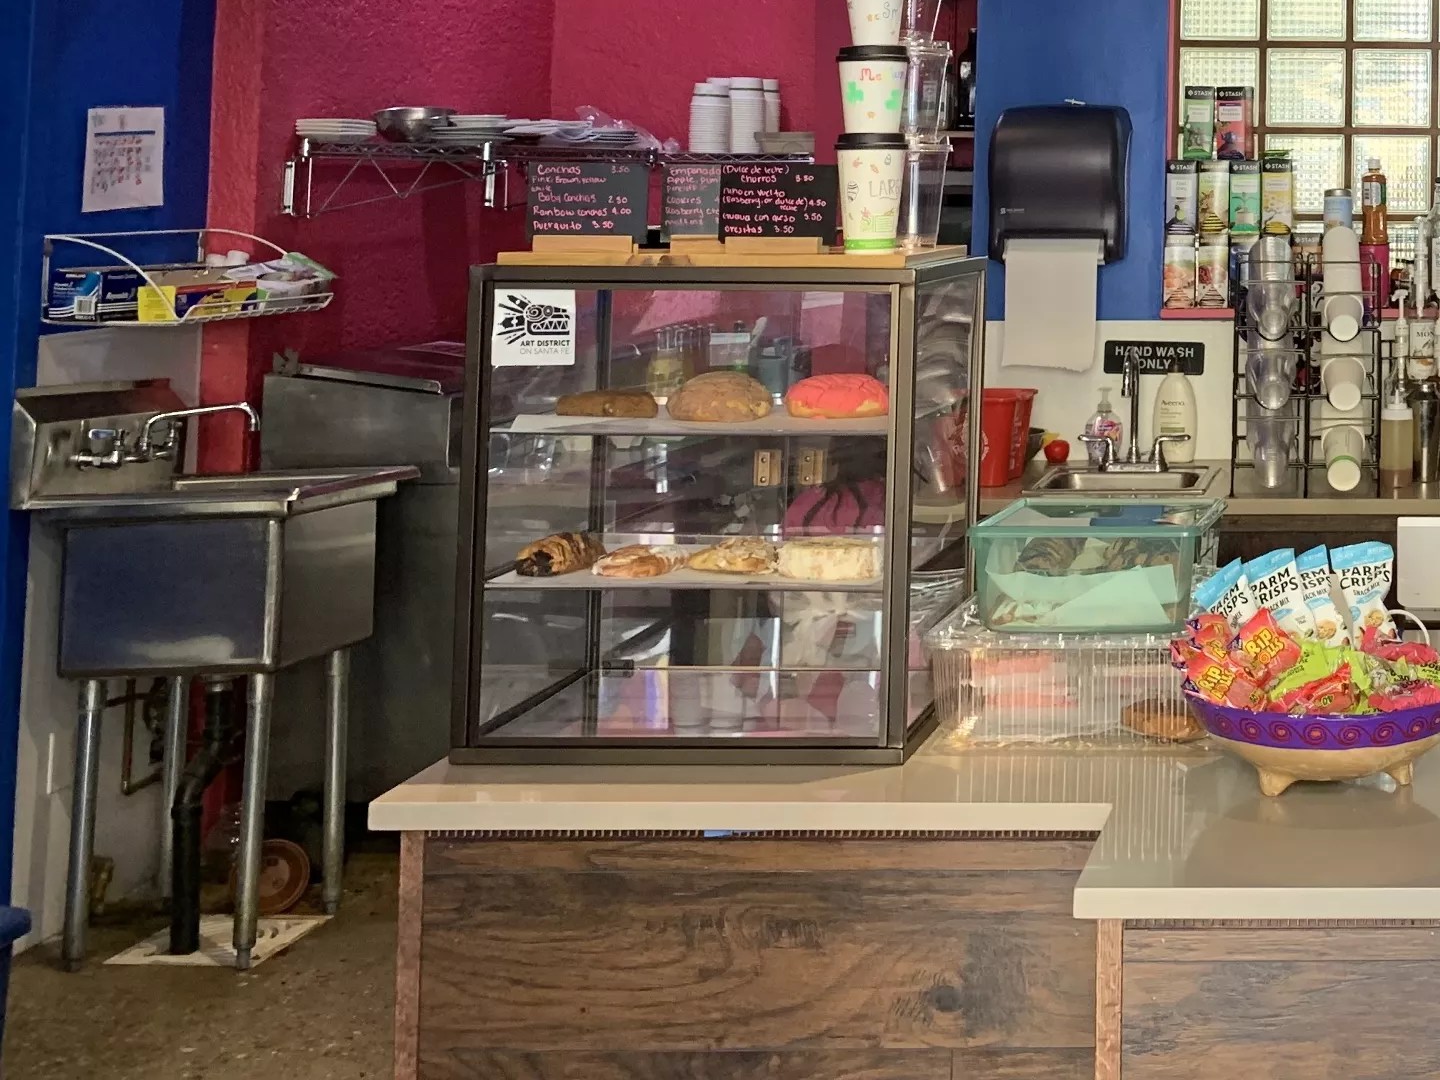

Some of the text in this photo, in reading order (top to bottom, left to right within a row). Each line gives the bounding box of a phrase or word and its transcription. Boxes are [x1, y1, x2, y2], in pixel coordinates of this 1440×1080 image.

[1156, 346, 1195, 358] WASH
[1138, 358, 1172, 370] ONLY
[1341, 563, 1388, 581] PARM
[1339, 570, 1392, 595] CRISPS
